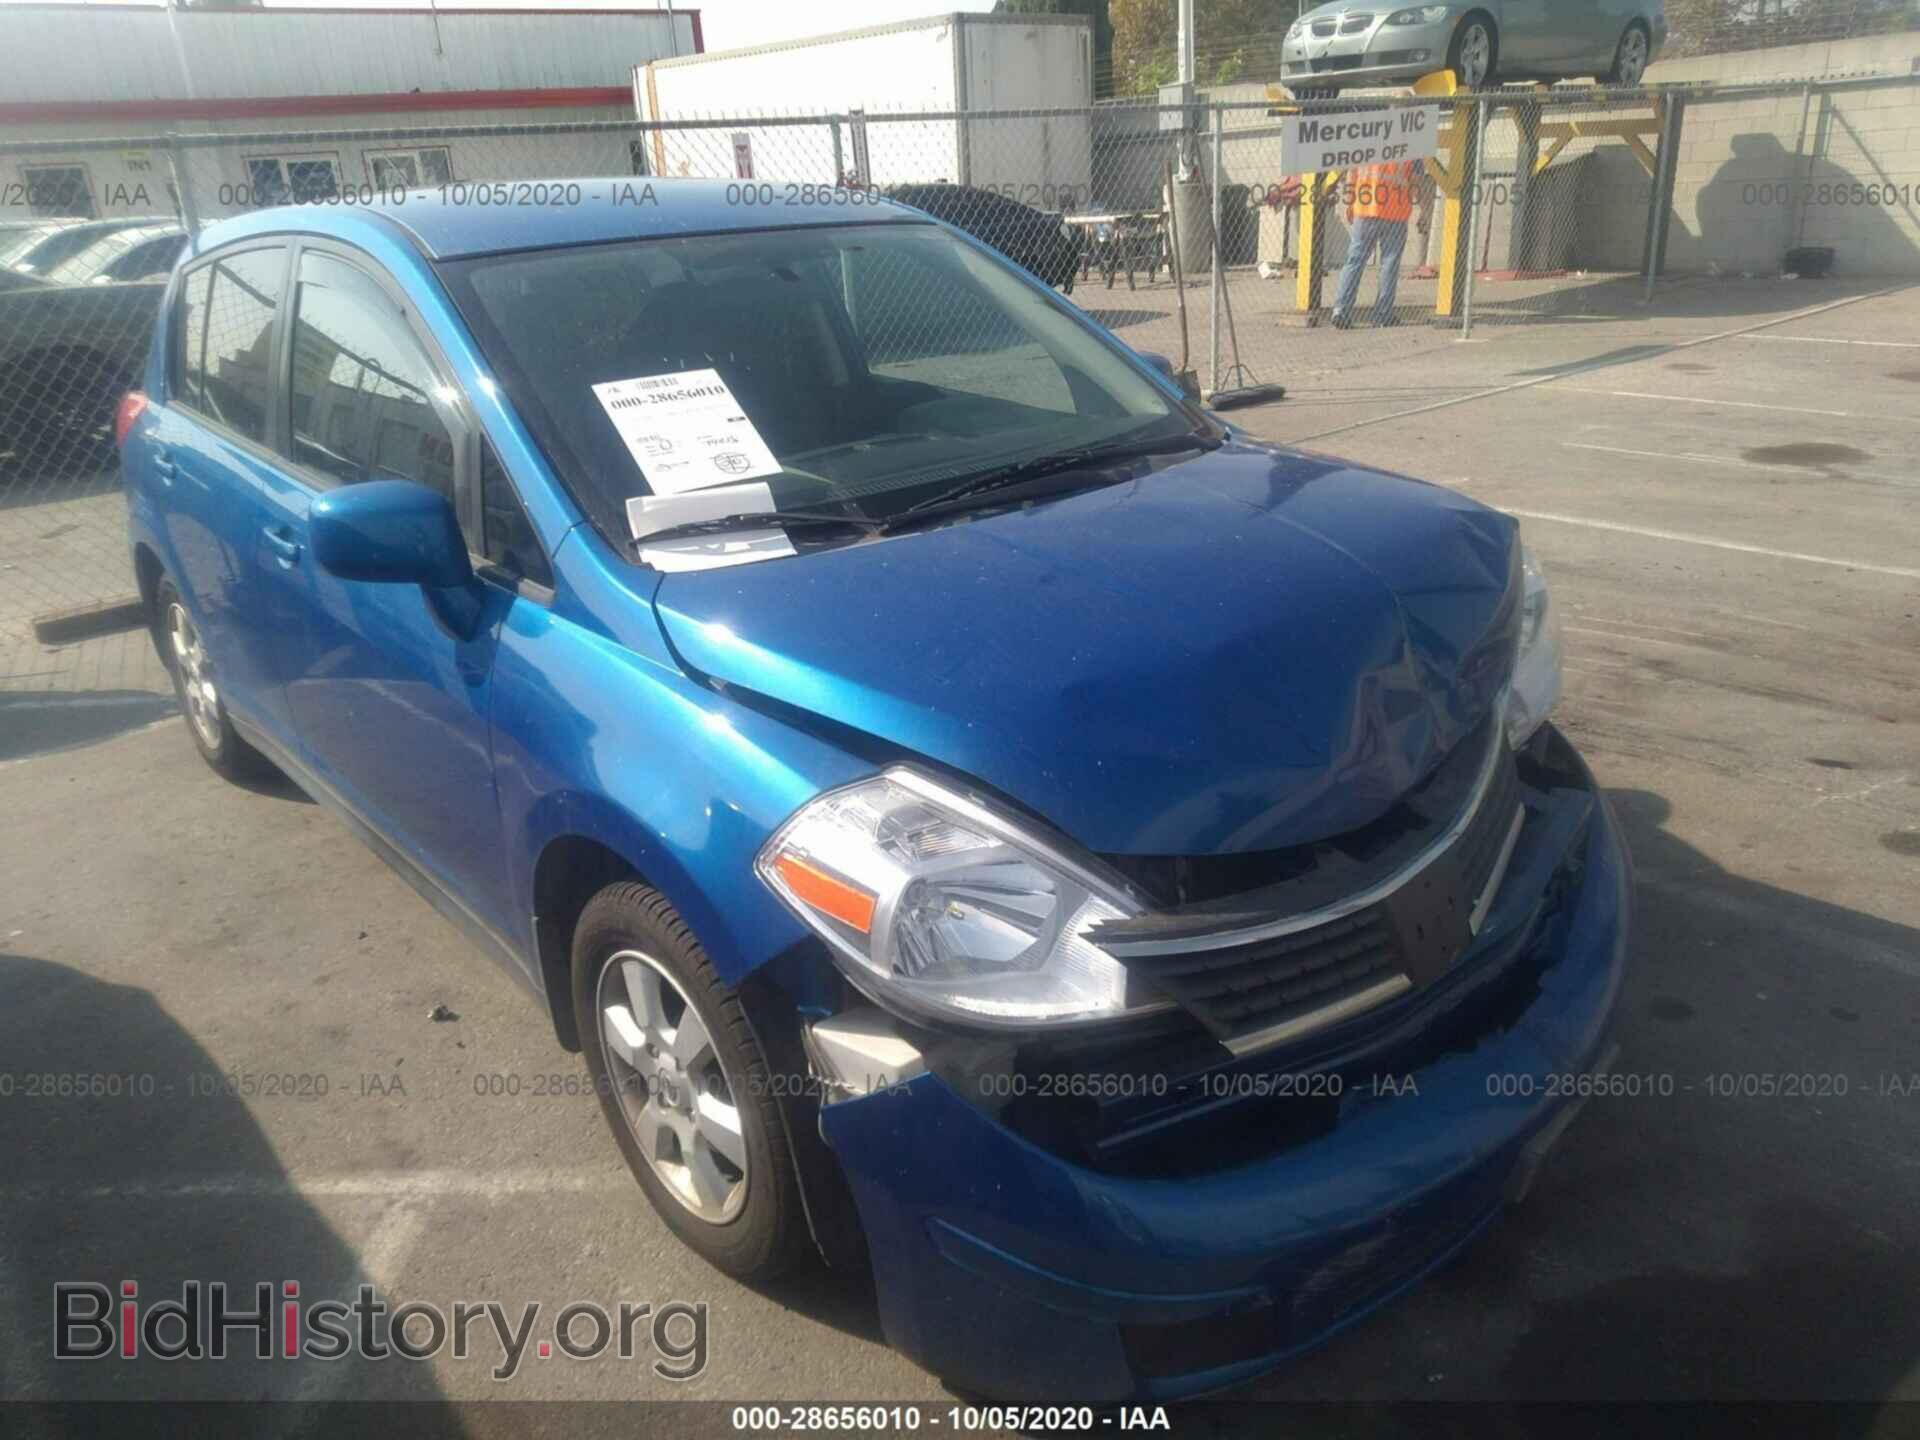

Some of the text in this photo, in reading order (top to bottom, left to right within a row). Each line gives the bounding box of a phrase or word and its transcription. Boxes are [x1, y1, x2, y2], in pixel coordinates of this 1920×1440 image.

[1299, 111, 1425, 144] Mercury VIC
[1321, 144, 1408, 167] DROP OFF
[611, 385, 726, 410] 000-28656010
